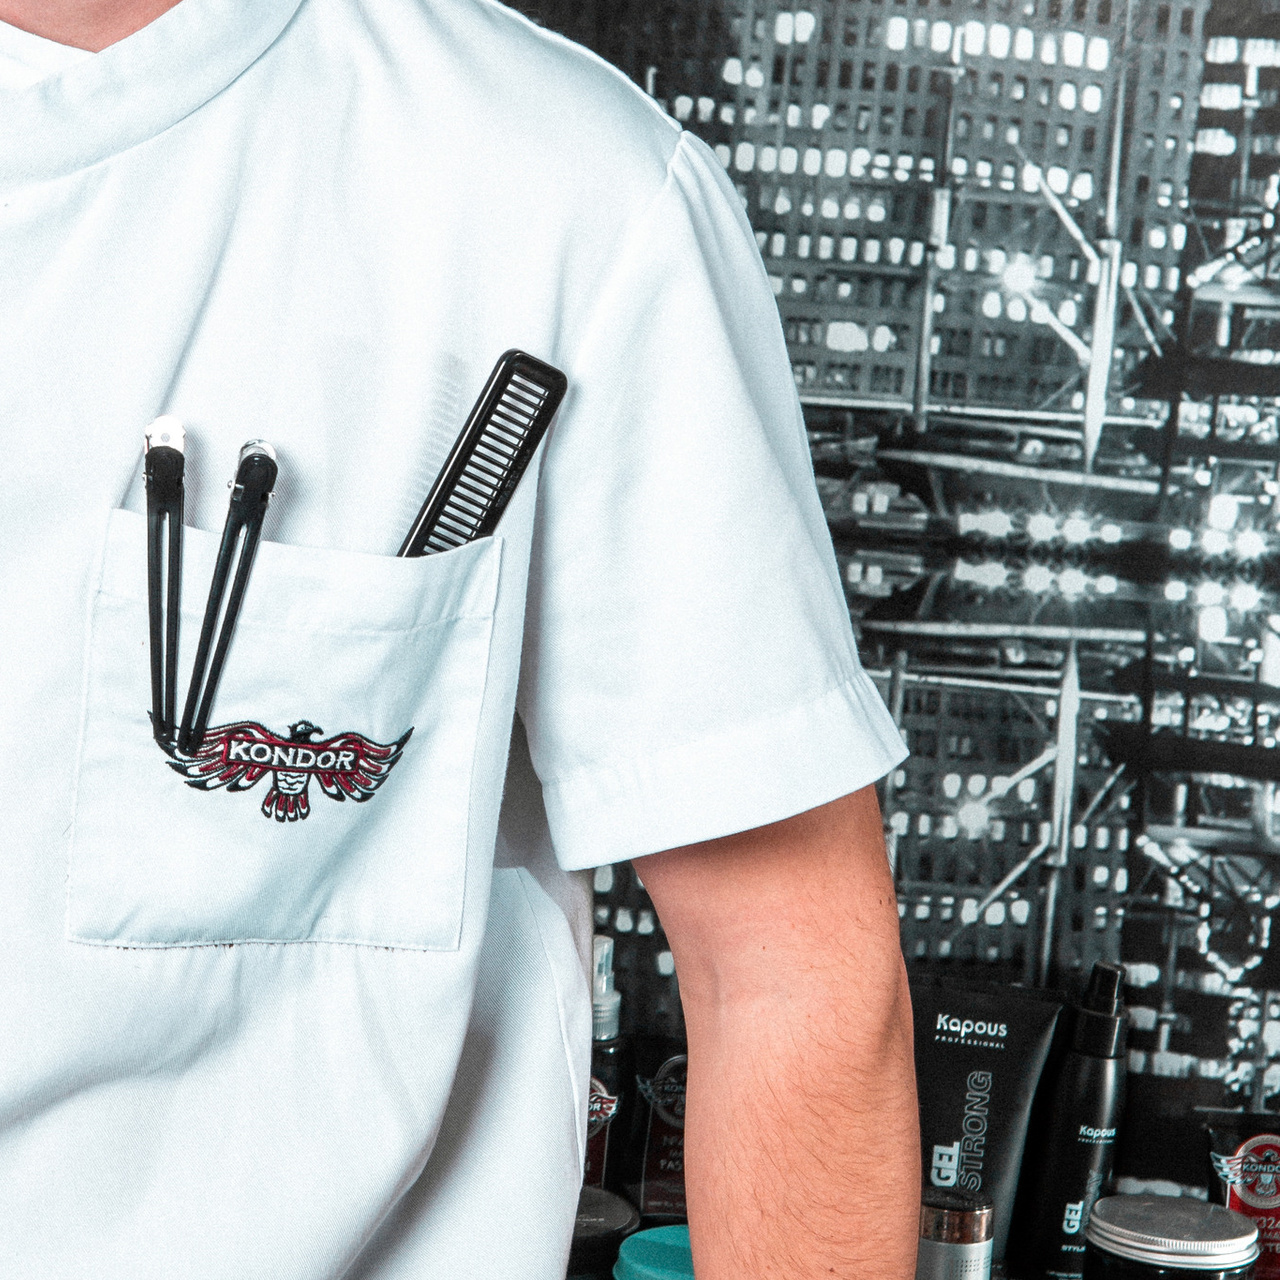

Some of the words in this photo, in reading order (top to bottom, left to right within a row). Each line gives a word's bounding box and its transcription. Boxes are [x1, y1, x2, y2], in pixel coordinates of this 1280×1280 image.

[228, 740, 356, 771] KONDOR
[934, 1035, 1006, 1049] PROFESSIONAL
[936, 1013, 1008, 1038] Kapous
[959, 1070, 993, 1192] STRONG
[930, 1141, 960, 1187] GEL
[1062, 1200, 1084, 1235] GEL
